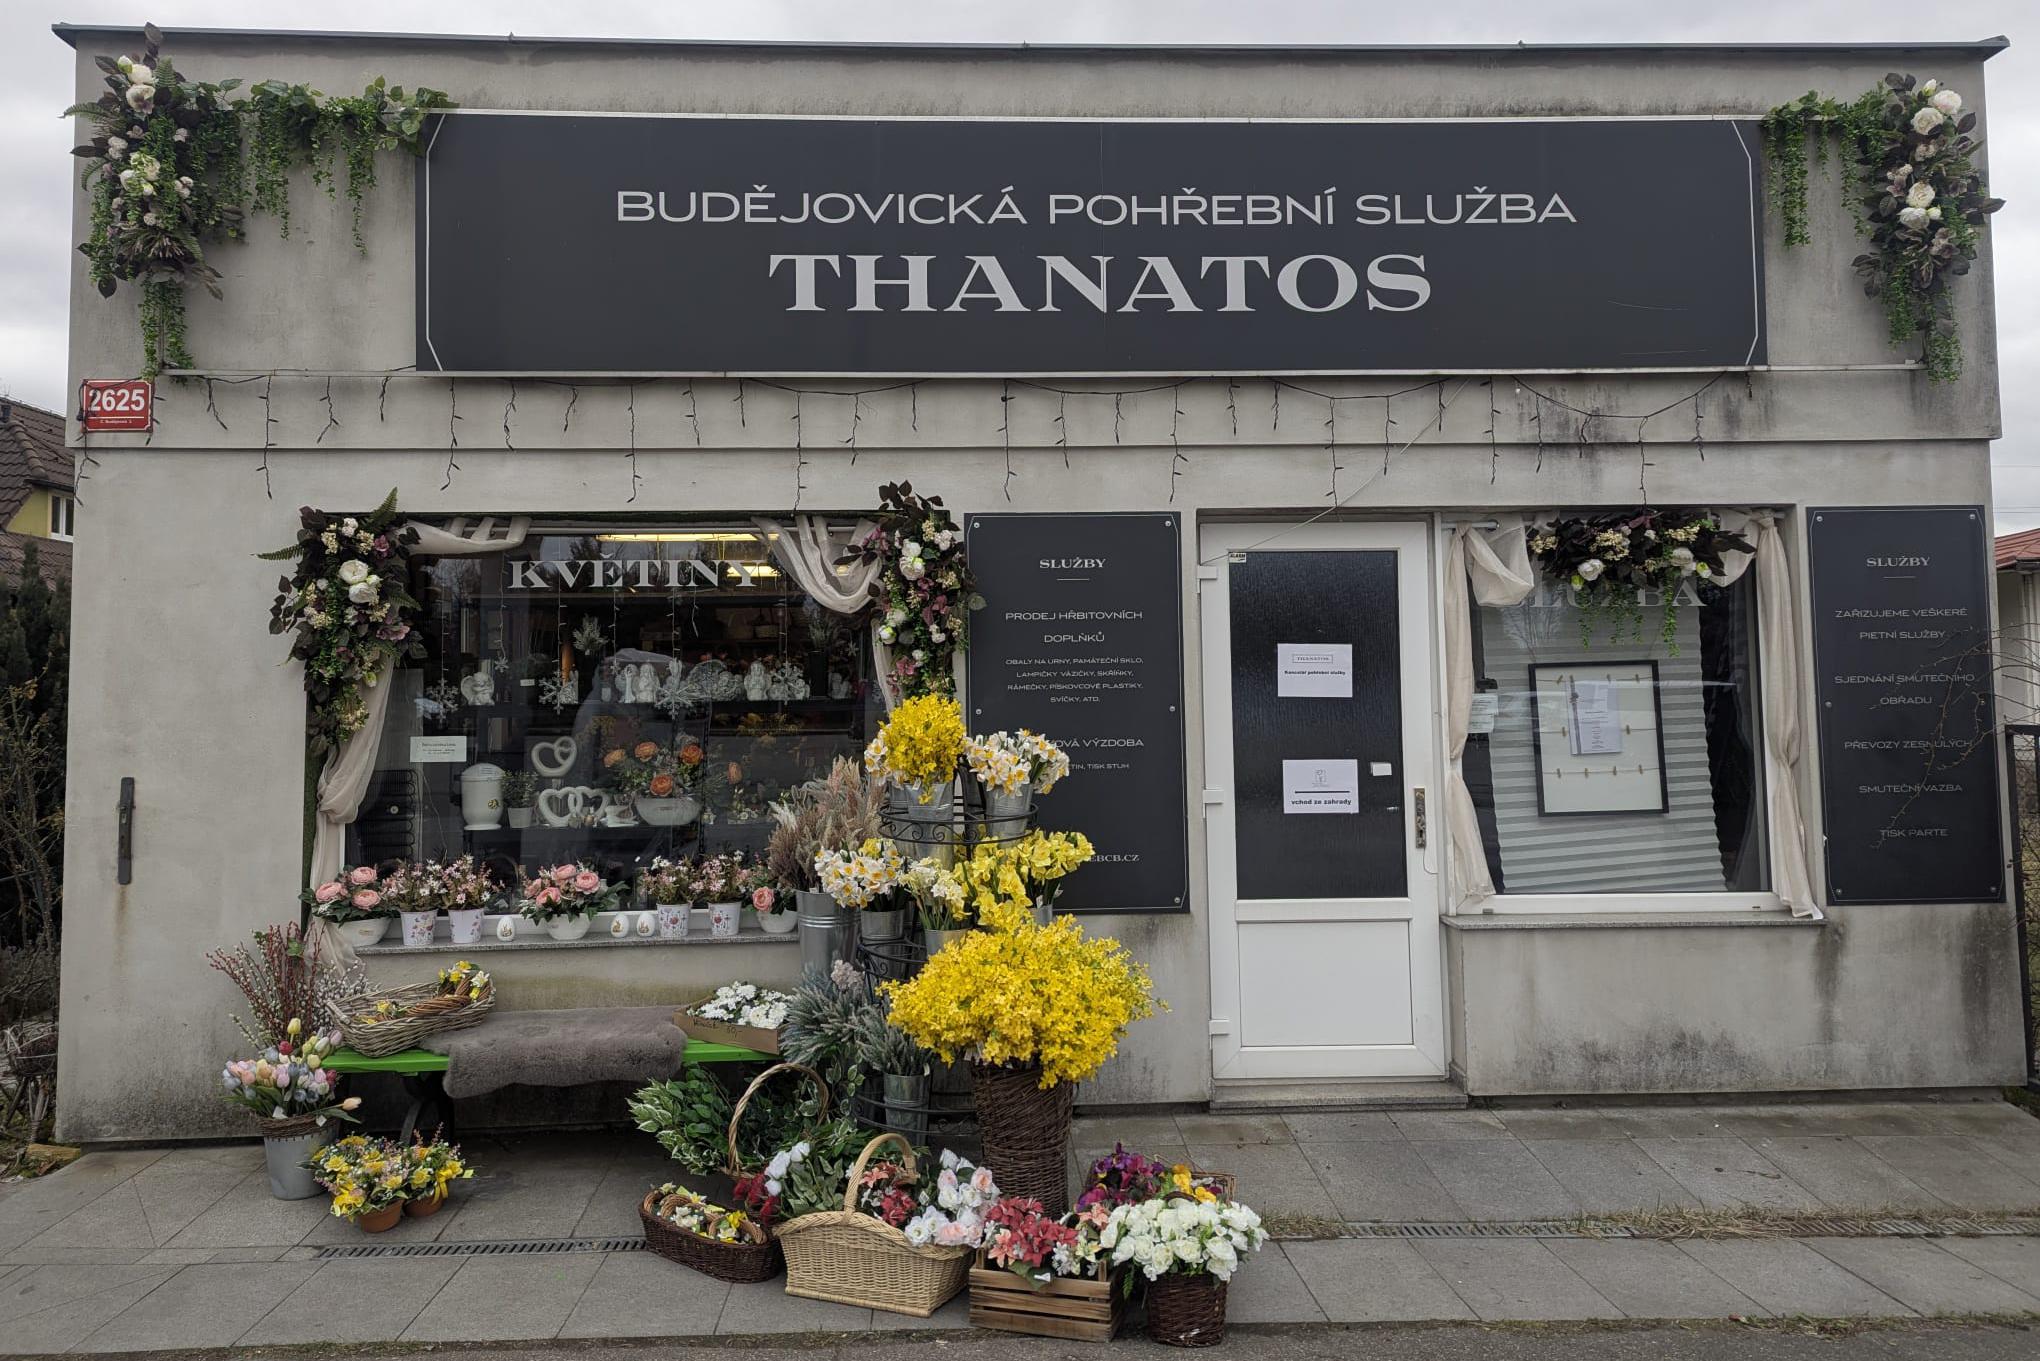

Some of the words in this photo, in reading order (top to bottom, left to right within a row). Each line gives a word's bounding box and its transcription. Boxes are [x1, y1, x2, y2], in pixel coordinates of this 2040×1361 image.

[617, 184, 1028, 225] BUDĚJOVICKÁ
[1049, 186, 1337, 226] POHŘEBNÍ
[1355, 185, 1577, 225] SLUŽBA
[768, 253, 1432, 313] THANATOS
[88, 388, 145, 411] 2625
[1039, 556, 1106, 569] SLUŽBY
[1866, 555, 1931, 568] SLUŽBY
[507, 552, 769, 588] KVĚTINY
[1005, 612, 1056, 621] PRODEJ
[1058, 609, 1143, 621] HŘBITOVNÍCH
[1835, 608, 1910, 618] ZAŘIZUJEME
[1914, 606, 1968, 617] VEŠKERÉ
[1044, 631, 1105, 643] DOPLŇKŮ
[1859, 630, 1897, 640] PIETNÍ
[1899, 629, 1946, 639] SLUŽBY
[1073, 656, 1119, 665] PAMÁTEČNÍ
[1835, 672, 1895, 684] SJEDNÁNÍ
[1896, 671, 1976, 684] SMUTEČNÍHO
[1880, 695, 1932, 706] OBŘADU
[1083, 737, 1144, 748] VÝZDOBA
[1844, 739, 1900, 750] PŘEVOZY
[1859, 783, 1921, 793] SMUTEČNÍ
[1923, 784, 1963, 792] VAZBA
[1324, 798, 1352, 806] zahrady
[1880, 828, 1906, 838] TISK
